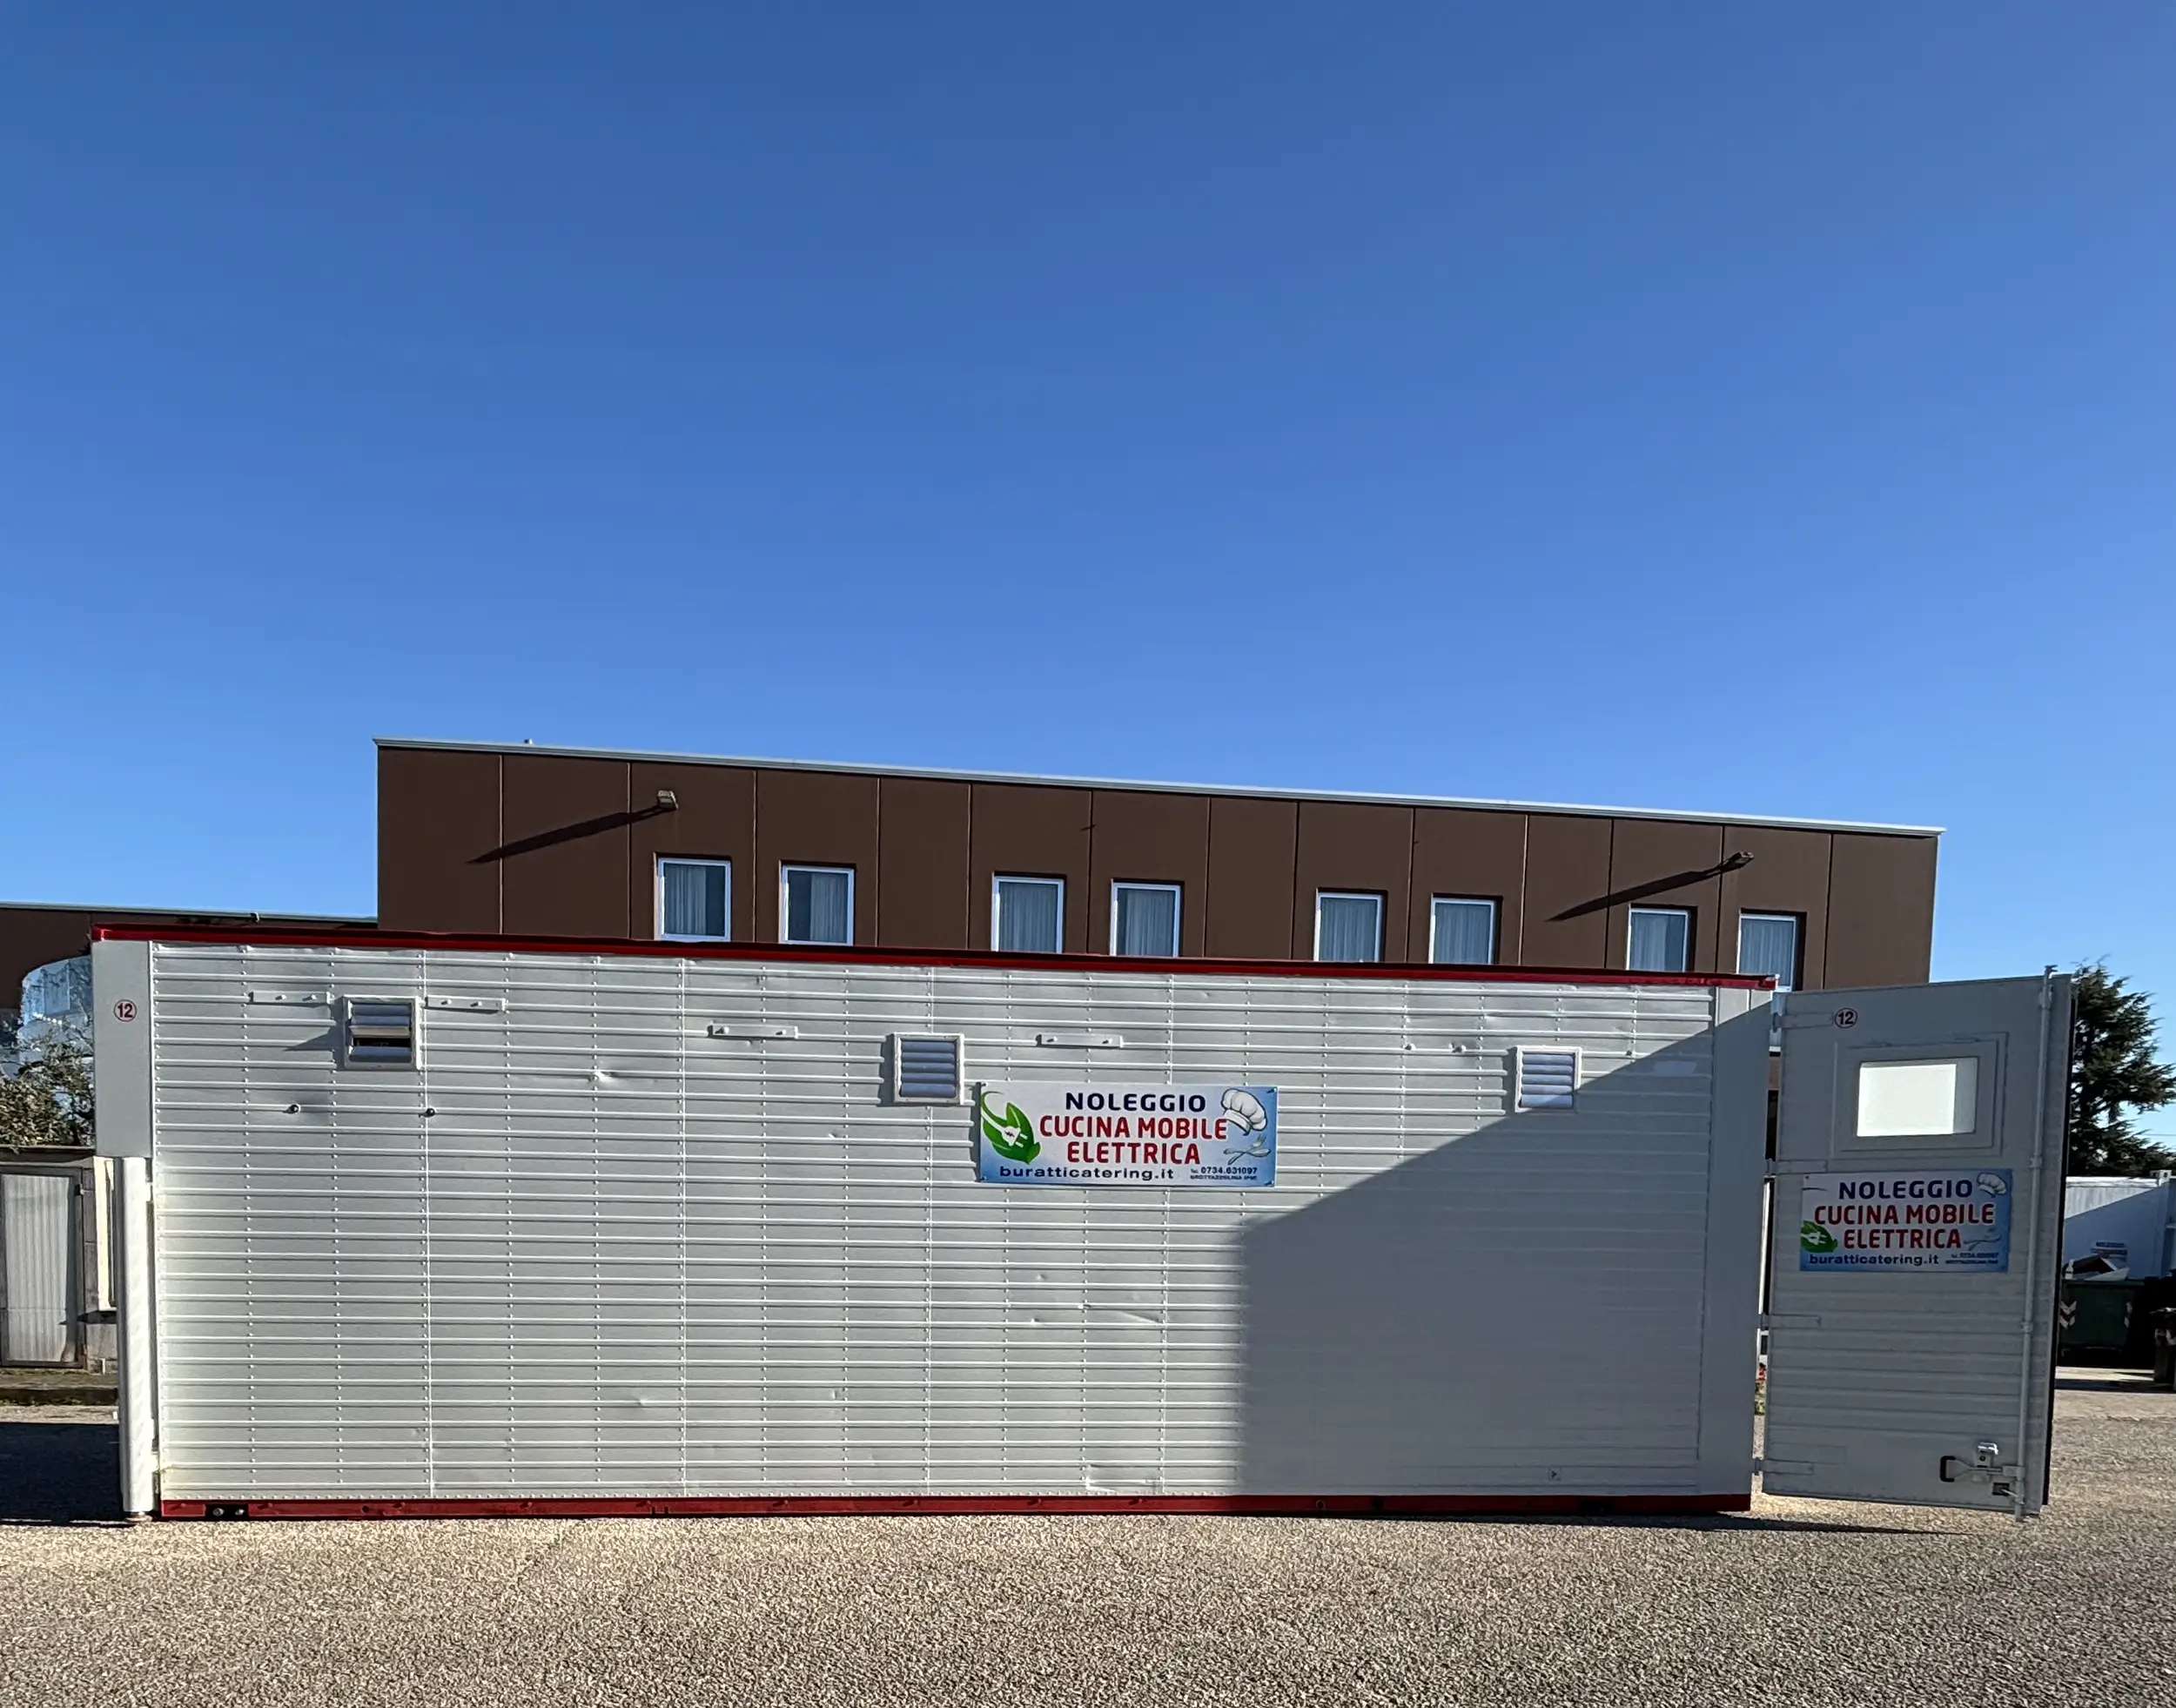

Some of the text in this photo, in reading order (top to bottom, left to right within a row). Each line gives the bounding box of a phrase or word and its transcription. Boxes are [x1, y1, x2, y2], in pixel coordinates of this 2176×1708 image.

[117, 1002, 133, 1018] 12
[1837, 1011, 1854, 1025] 12
[1065, 1092, 1206, 1113] NOLEGGIO
[1039, 1115, 1227, 1140] CUCINA MOBILE
[1067, 1141, 1200, 1165] ELETTRICA
[999, 1166, 1174, 1181] buratticatering.it
[1838, 1180, 1973, 1200] NOLEGGIO
[1814, 1203, 1995, 1225] CUCINA MOBILE
[1843, 1228, 1962, 1249] ELETTRICA
[1809, 1254, 1939, 1267] buratticatering.it
